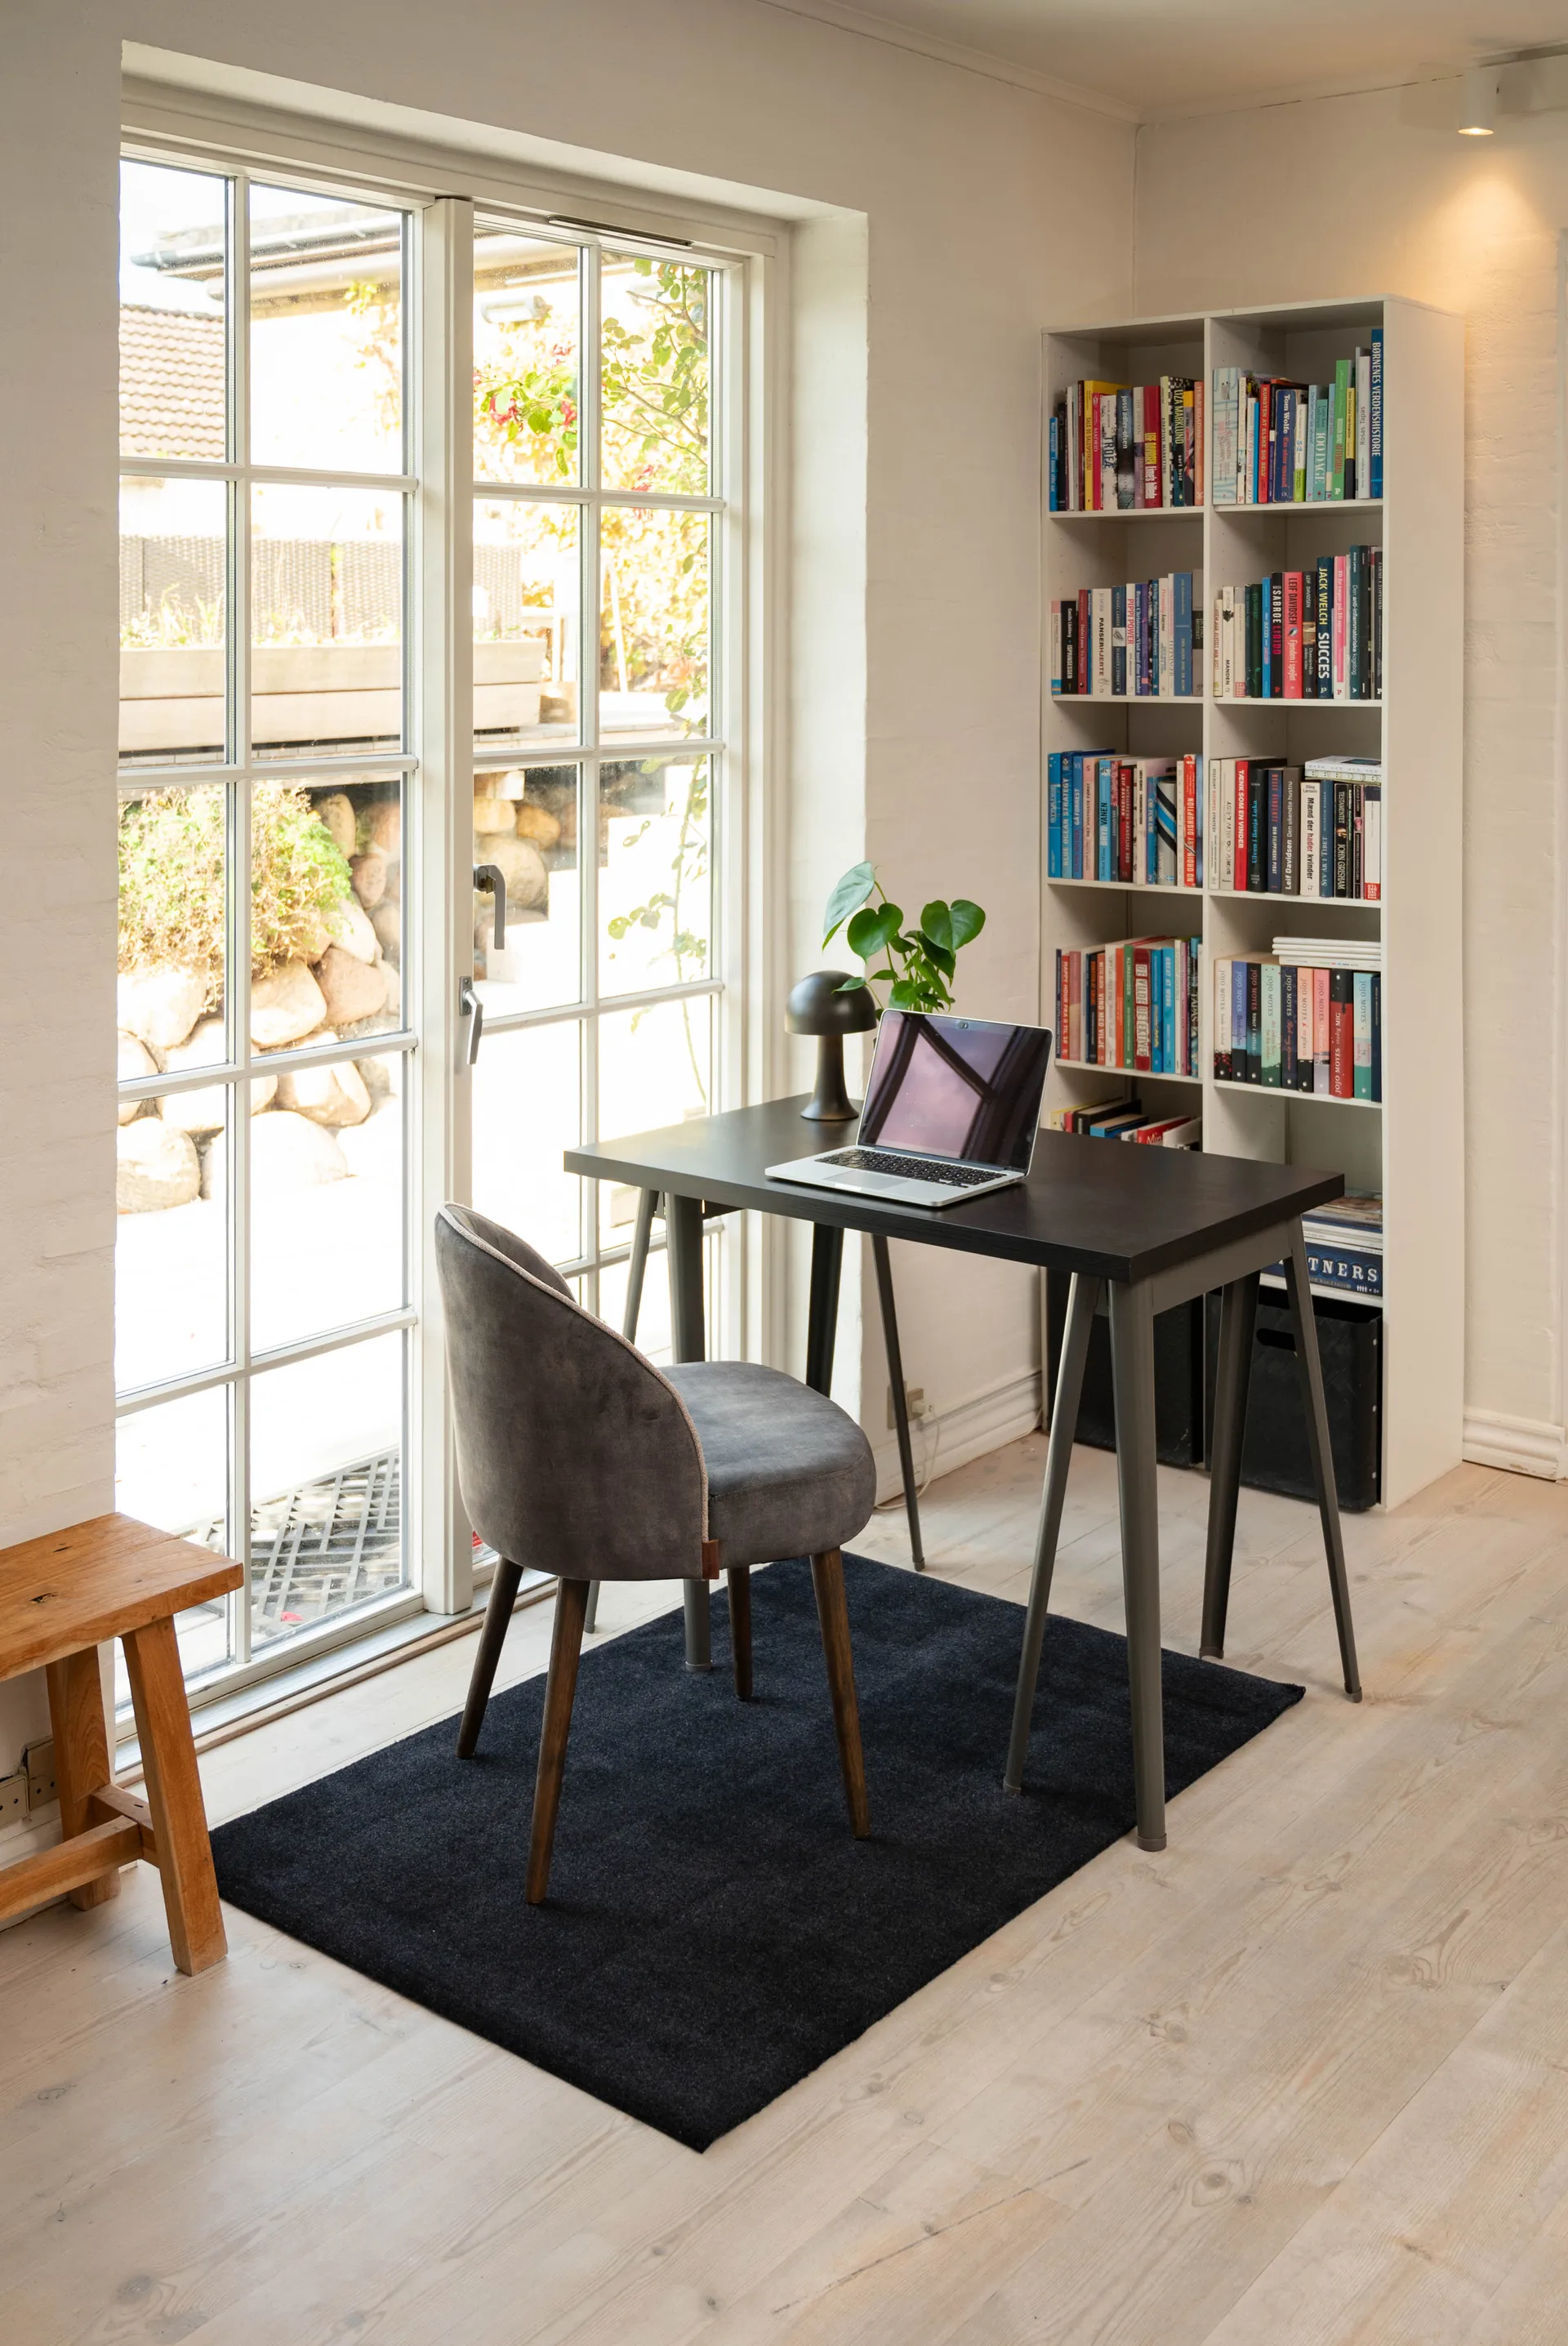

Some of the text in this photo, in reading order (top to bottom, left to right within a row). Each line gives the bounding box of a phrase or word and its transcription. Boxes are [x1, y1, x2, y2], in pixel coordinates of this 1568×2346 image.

[1372, 342, 1381, 457] BØRNENES VERDENSHISTORIE
[1174, 390, 1184, 444] LIZA MARKLUND
[1104, 436, 1114, 469] TROFÆ
[1145, 433, 1156, 441] LEIF
[1314, 433, 1325, 484] 100 DAGE
[1289, 578, 1298, 591] LEIF
[1319, 568, 1328, 625] JACK WELCH
[1272, 590, 1281, 655] SABROE LIBIDO
[1289, 593, 1298, 625] DAVIDSEN
[1288, 640, 1298, 660] Fjenden
[1318, 632, 1330, 679] SUCCES
[1288, 663, 1298, 681] spejlet
[1187, 798, 1195, 836] DISRUPTION
[1238, 810, 1244, 820] EN
[1337, 844, 1345, 860] JOHN
[1187, 873, 1194, 882] NO
[1165, 979, 1171, 987] AT
[1137, 965, 1147, 1056] DE VILDE DETEKTIVER
[1307, 1256, 1378, 1282] TNERS
